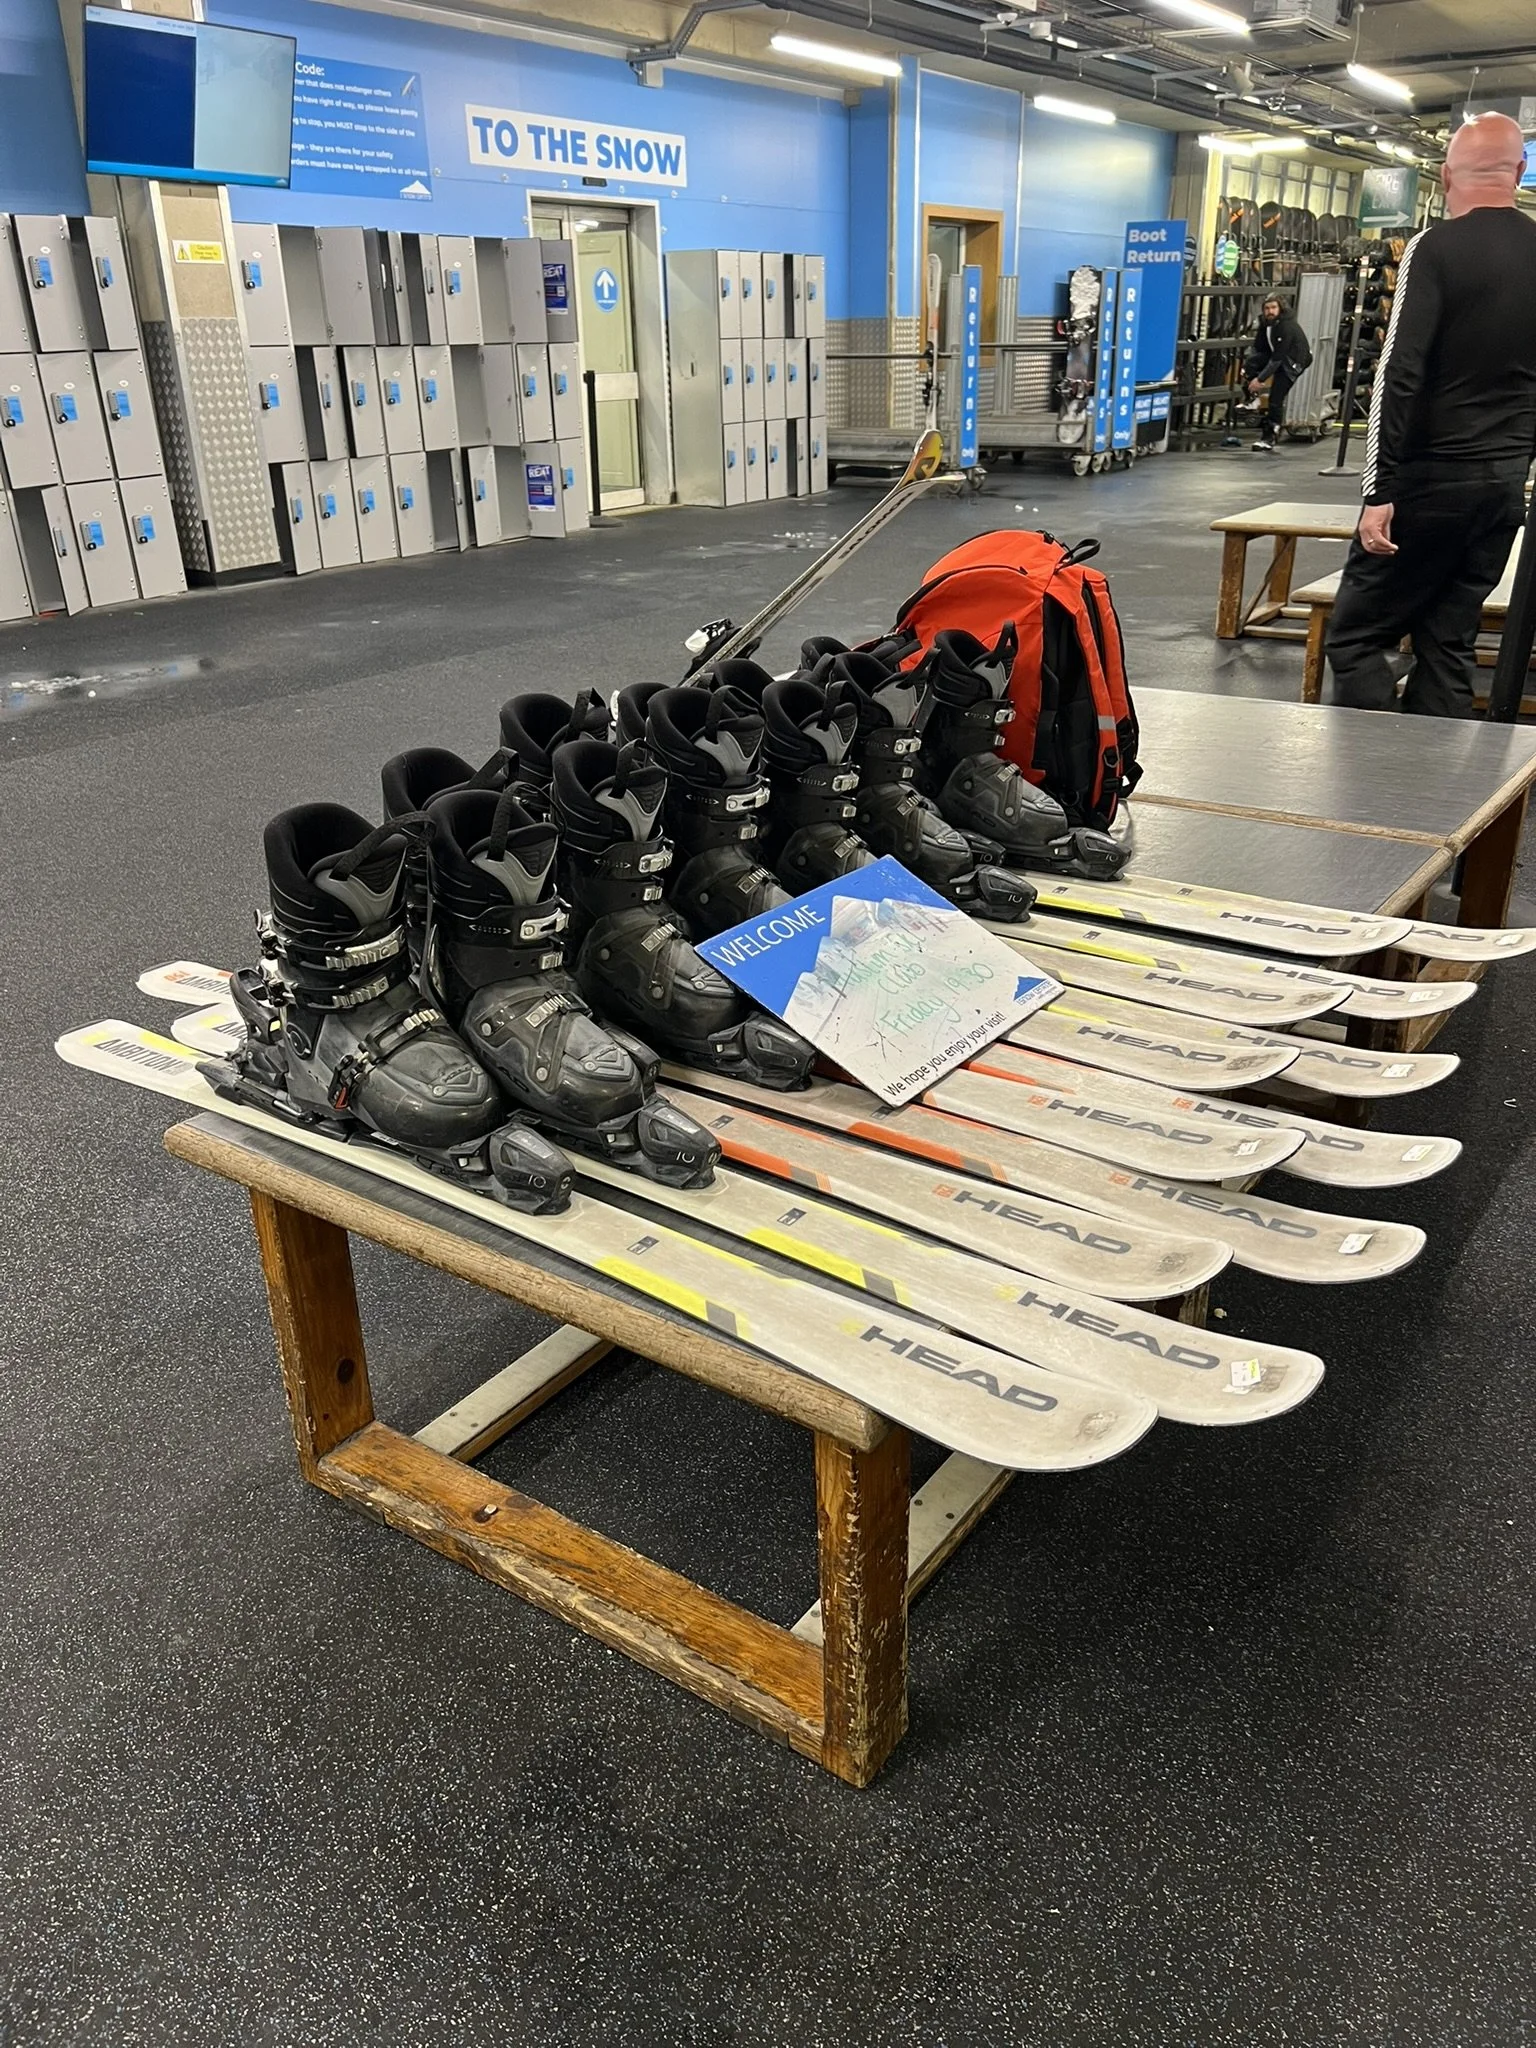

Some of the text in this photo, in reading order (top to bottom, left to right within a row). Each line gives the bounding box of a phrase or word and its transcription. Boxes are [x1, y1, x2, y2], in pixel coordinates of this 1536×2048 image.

[295, 62, 325, 76] Code:
[306, 80, 318, 88] that
[320, 81, 334, 90] does
[303, 95, 318, 104] have
[320, 96, 334, 107] right
[335, 99, 342, 107] of
[324, 120, 336, 129] you
[336, 120, 354, 130] MUST
[375, 126, 386, 134] the
[324, 145, 334, 154] are
[336, 145, 352, 155] there
[472, 116, 681, 176] TO THE SNOW
[326, 160, 342, 170] have
[1128, 228, 1167, 243] Boot
[1126, 249, 1182, 263] Return
[966, 286, 977, 432] Returns
[1119, 287, 1136, 417] Returns
[710, 904, 826, 967] WELCOME
[1220, 911, 1351, 936] HEAD
[1144, 972, 1285, 1002] HEAD
[1263, 965, 1406, 997] HEAD
[880, 994, 962, 1038] Friday
[93, 1038, 184, 1075] AMBITION
[883, 1010, 1007, 1098] We hope you enjoy your visit!
[1080, 1026, 1227, 1064] HEAD
[1047, 1099, 1213, 1146] HEAD
[528, 1174, 547, 1189] 10
[953, 1191, 1132, 1255] HEAD
[1119, 1177, 1318, 1239] HEAD
[1016, 1290, 1221, 1370] HEAD
[860, 1324, 1059, 1413] HEAD
